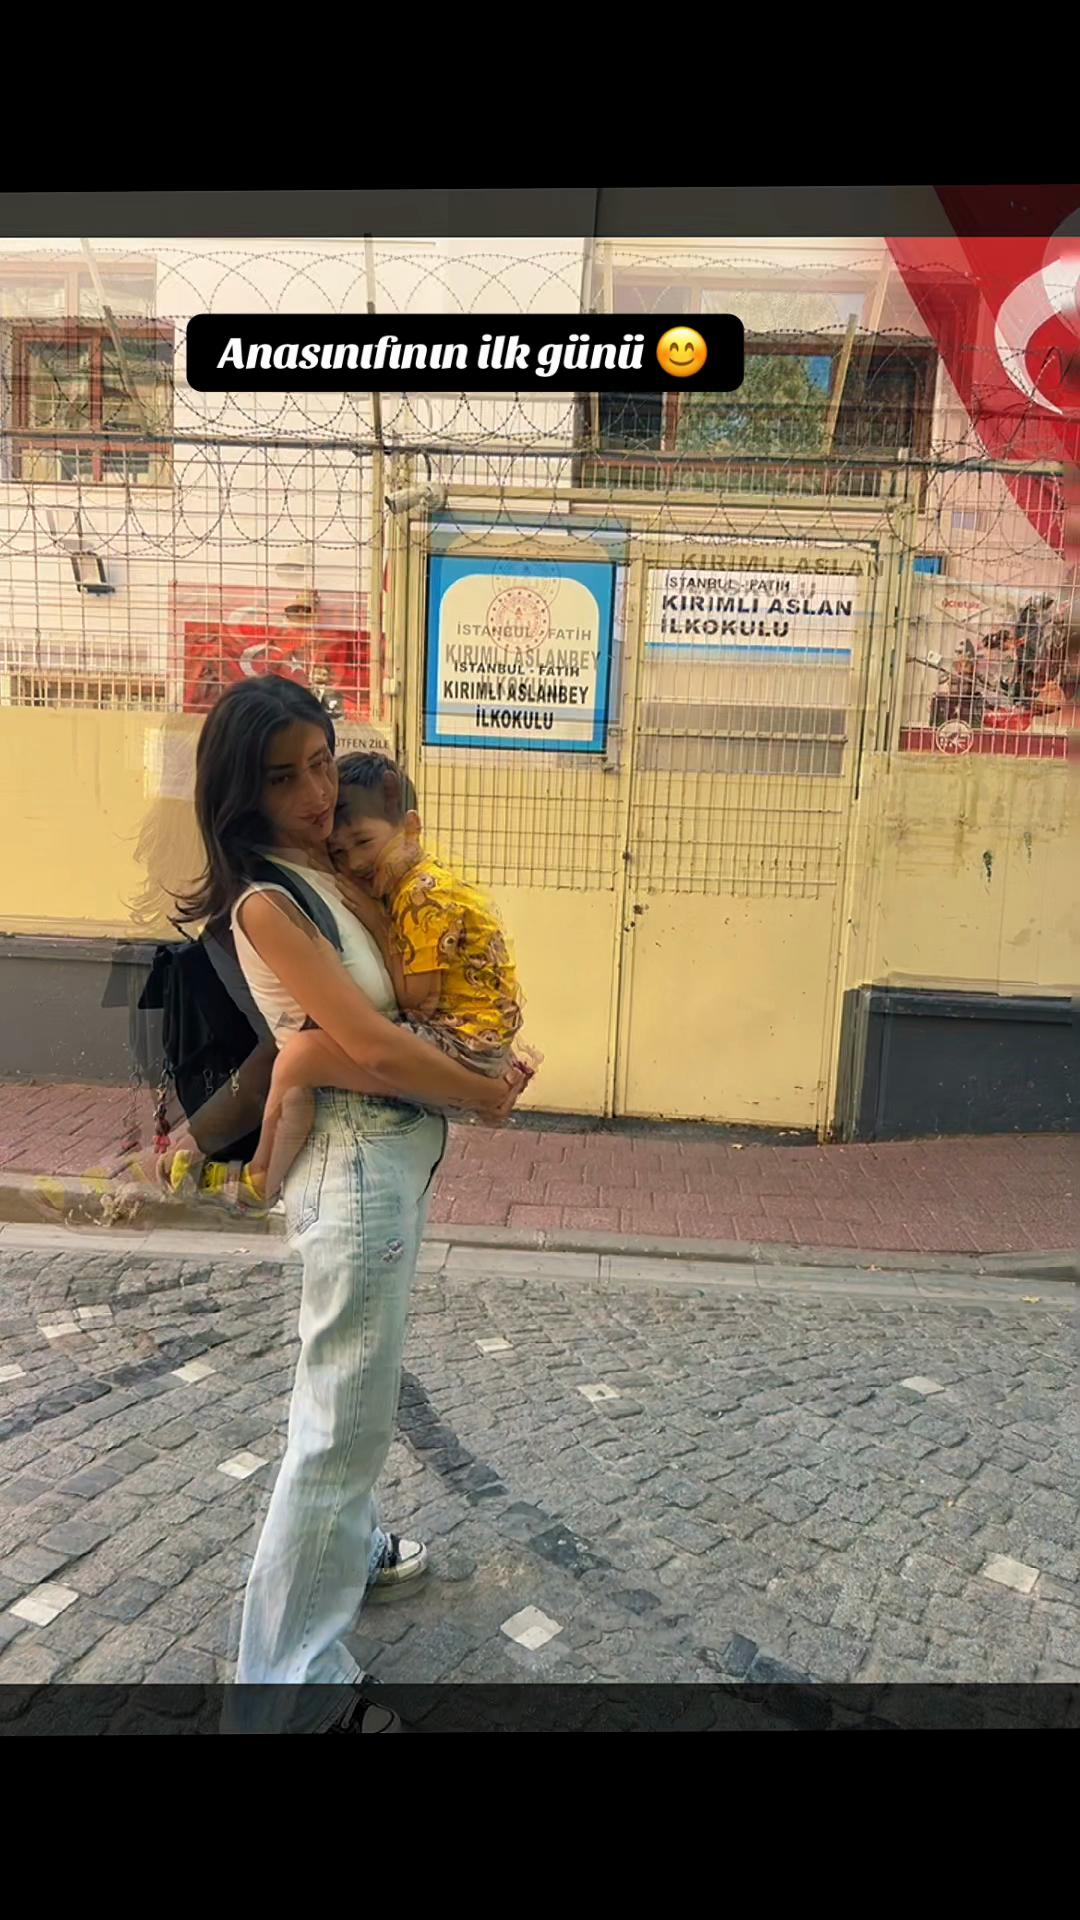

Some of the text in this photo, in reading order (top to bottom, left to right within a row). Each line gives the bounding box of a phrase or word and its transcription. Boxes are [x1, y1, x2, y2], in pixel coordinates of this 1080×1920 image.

[662, 595, 853, 617] KIRIMLI ASLAN
[547, 627, 592, 641] FATİH
[661, 614, 790, 638] İLKOKULU
[443, 680, 589, 705] KIRIMLI ASLANBEY
[475, 704, 554, 730] İLKOKULU
[335, 737, 367, 748] ÜTFEN
